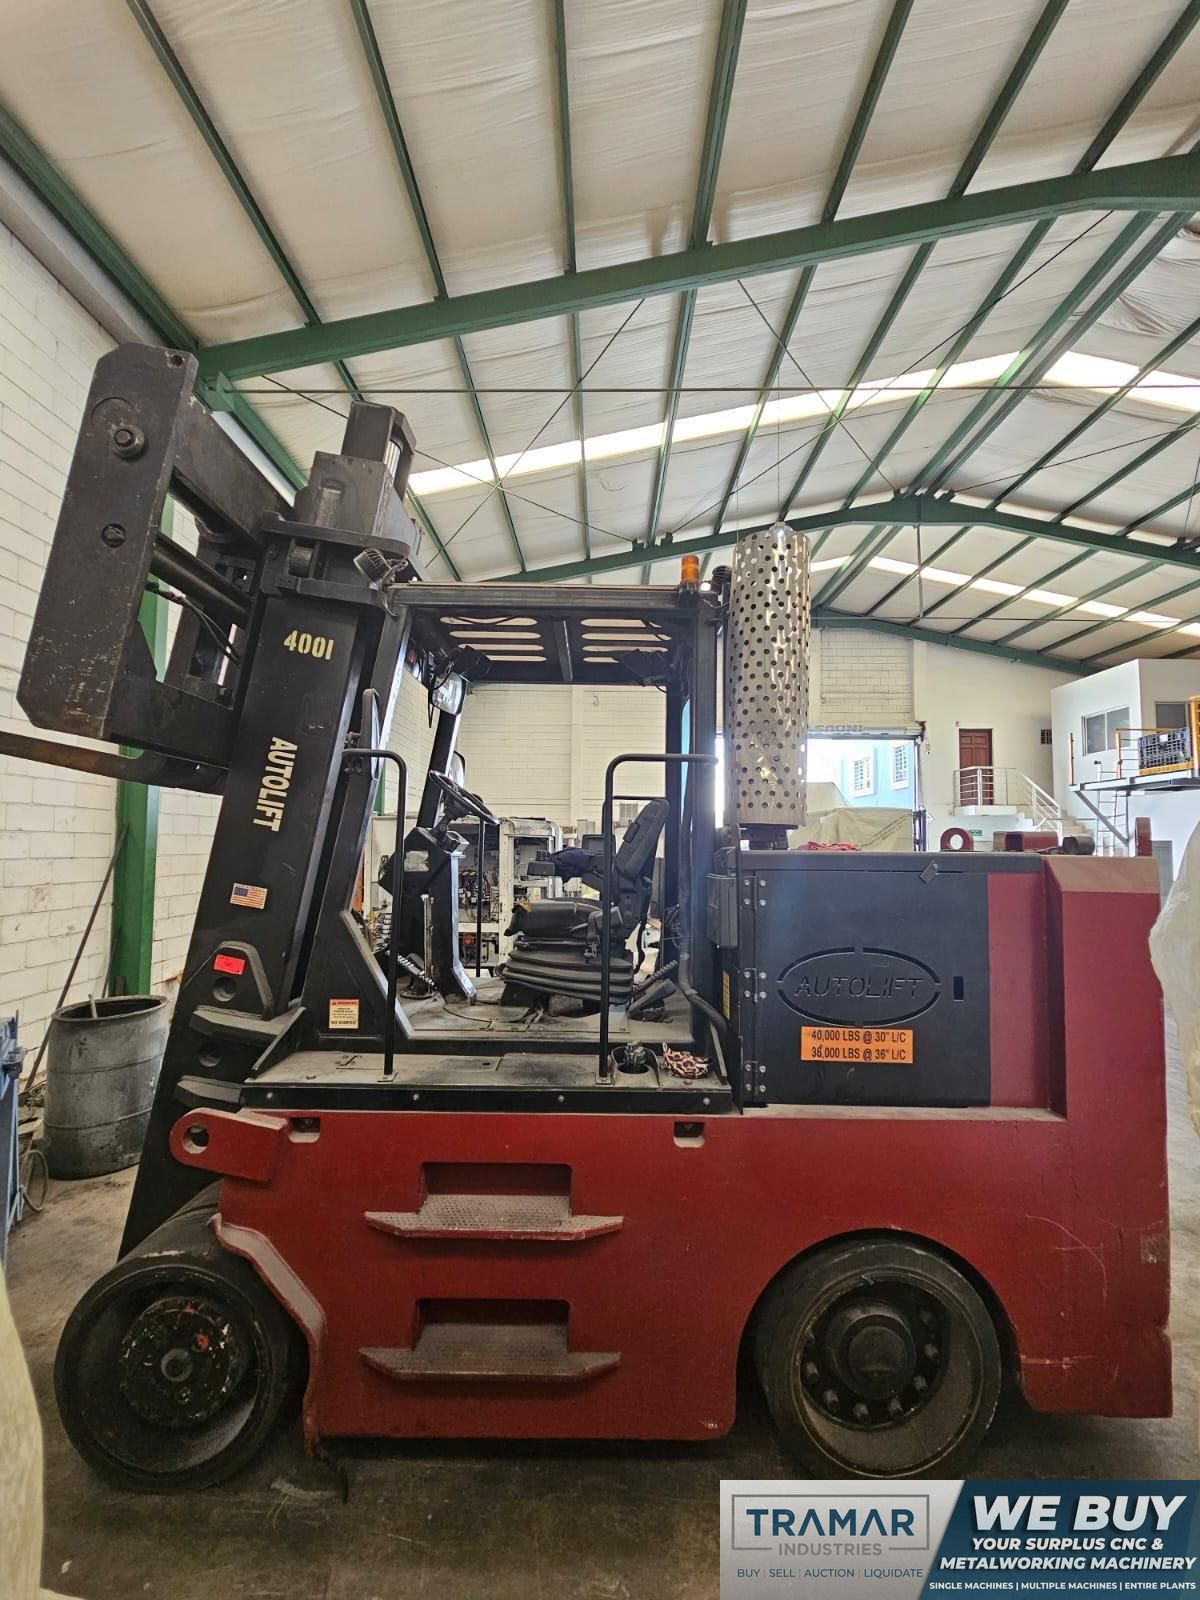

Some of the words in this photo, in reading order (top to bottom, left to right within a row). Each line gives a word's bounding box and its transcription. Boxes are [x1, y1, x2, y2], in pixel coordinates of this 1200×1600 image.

[283, 630, 334, 660] 4001
[253, 736, 298, 832] AUTOLIFT
[794, 976, 924, 998] AUTOLIFT
[811, 1029, 840, 1042] 40,000
[843, 1030, 860, 1041] LBS
[863, 1031, 873, 1044] @
[891, 1032, 906, 1043] L/C
[843, 1047, 860, 1059] LBS
[863, 1048, 873, 1061] @
[891, 1049, 906, 1060] L/C
